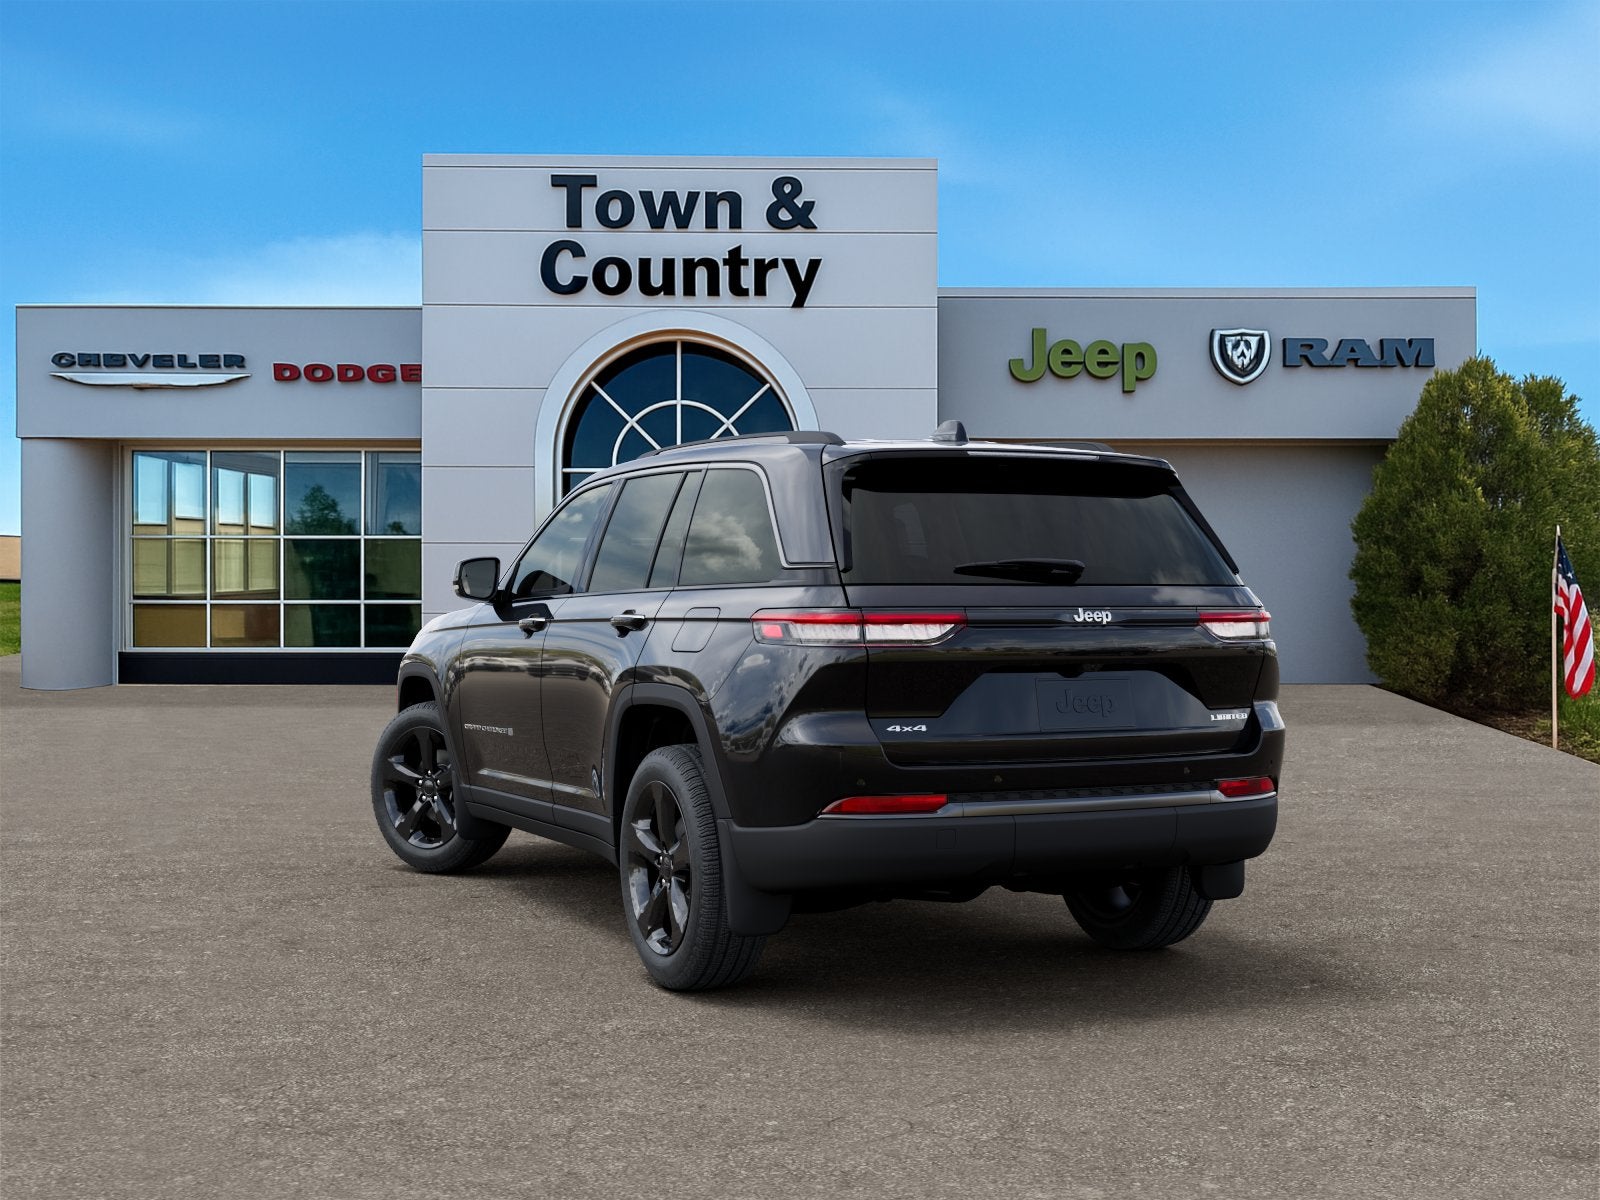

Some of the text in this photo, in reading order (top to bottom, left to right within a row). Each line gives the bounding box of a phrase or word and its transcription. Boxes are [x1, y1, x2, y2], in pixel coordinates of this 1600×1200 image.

[550, 174, 818, 230] Town &
[539, 239, 823, 308] Country
[1008, 327, 1158, 393] Jeep
[1282, 337, 1436, 368] RAM
[272, 362, 422, 383] DODGE
[1073, 607, 1113, 625] Jeep
[1055, 687, 1114, 719] Jeep
[886, 724, 927, 732] 4x4
